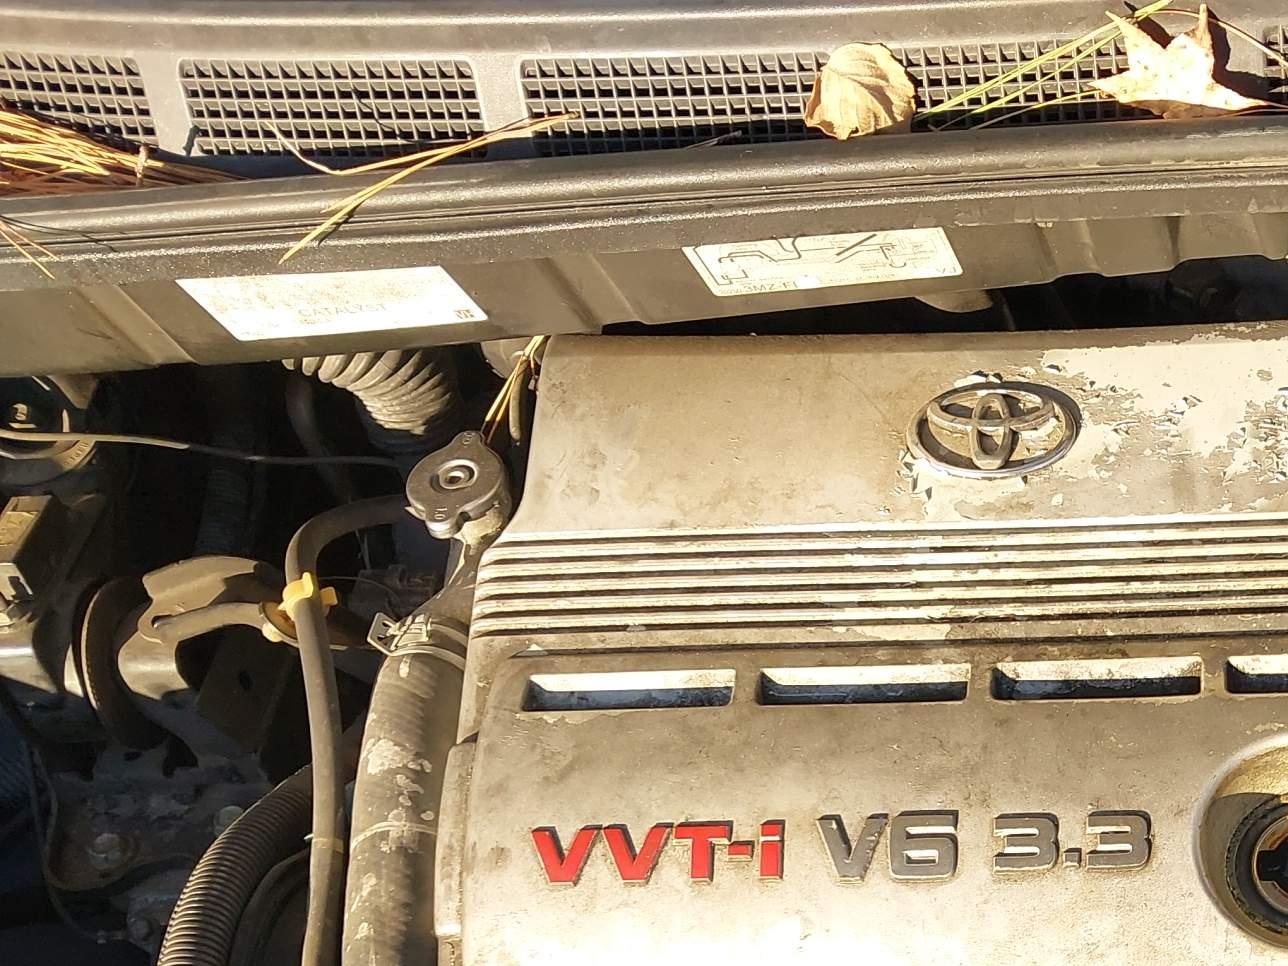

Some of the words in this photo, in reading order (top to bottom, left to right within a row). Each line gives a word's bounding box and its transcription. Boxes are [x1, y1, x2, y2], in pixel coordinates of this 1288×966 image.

[529, 818, 787, 887] VVT-i
[815, 809, 960, 885] V6
[991, 809, 1154, 876] 3.3
